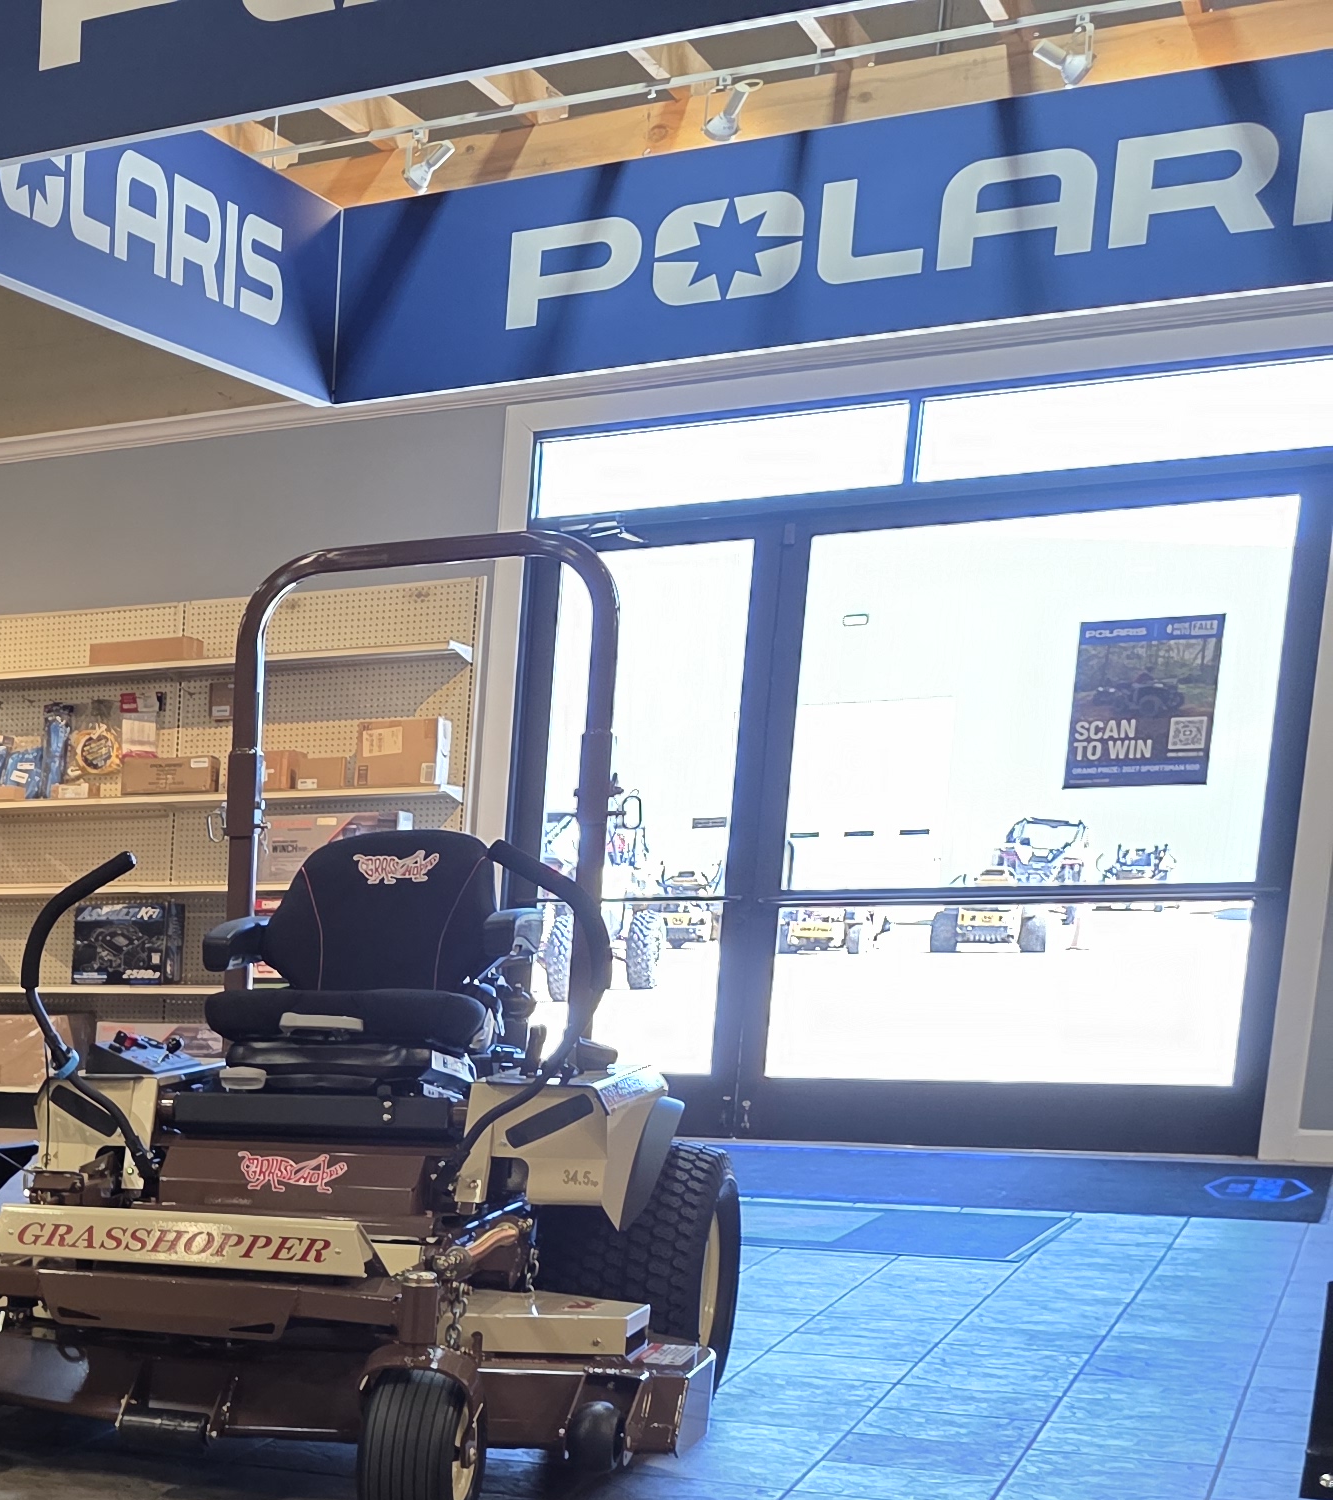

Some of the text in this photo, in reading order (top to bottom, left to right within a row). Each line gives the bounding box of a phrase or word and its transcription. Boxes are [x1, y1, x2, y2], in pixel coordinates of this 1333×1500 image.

[0, 149, 283, 326] OLARIS
[1085, 627, 1147, 638] POLARIS
[1192, 620, 1215, 631] FALL
[1075, 719, 1136, 740] SCAN
[1073, 739, 1153, 760] TO WIN
[271, 843, 299, 854] WINCH
[17, 1221, 333, 1264] GRASSHOPPER
